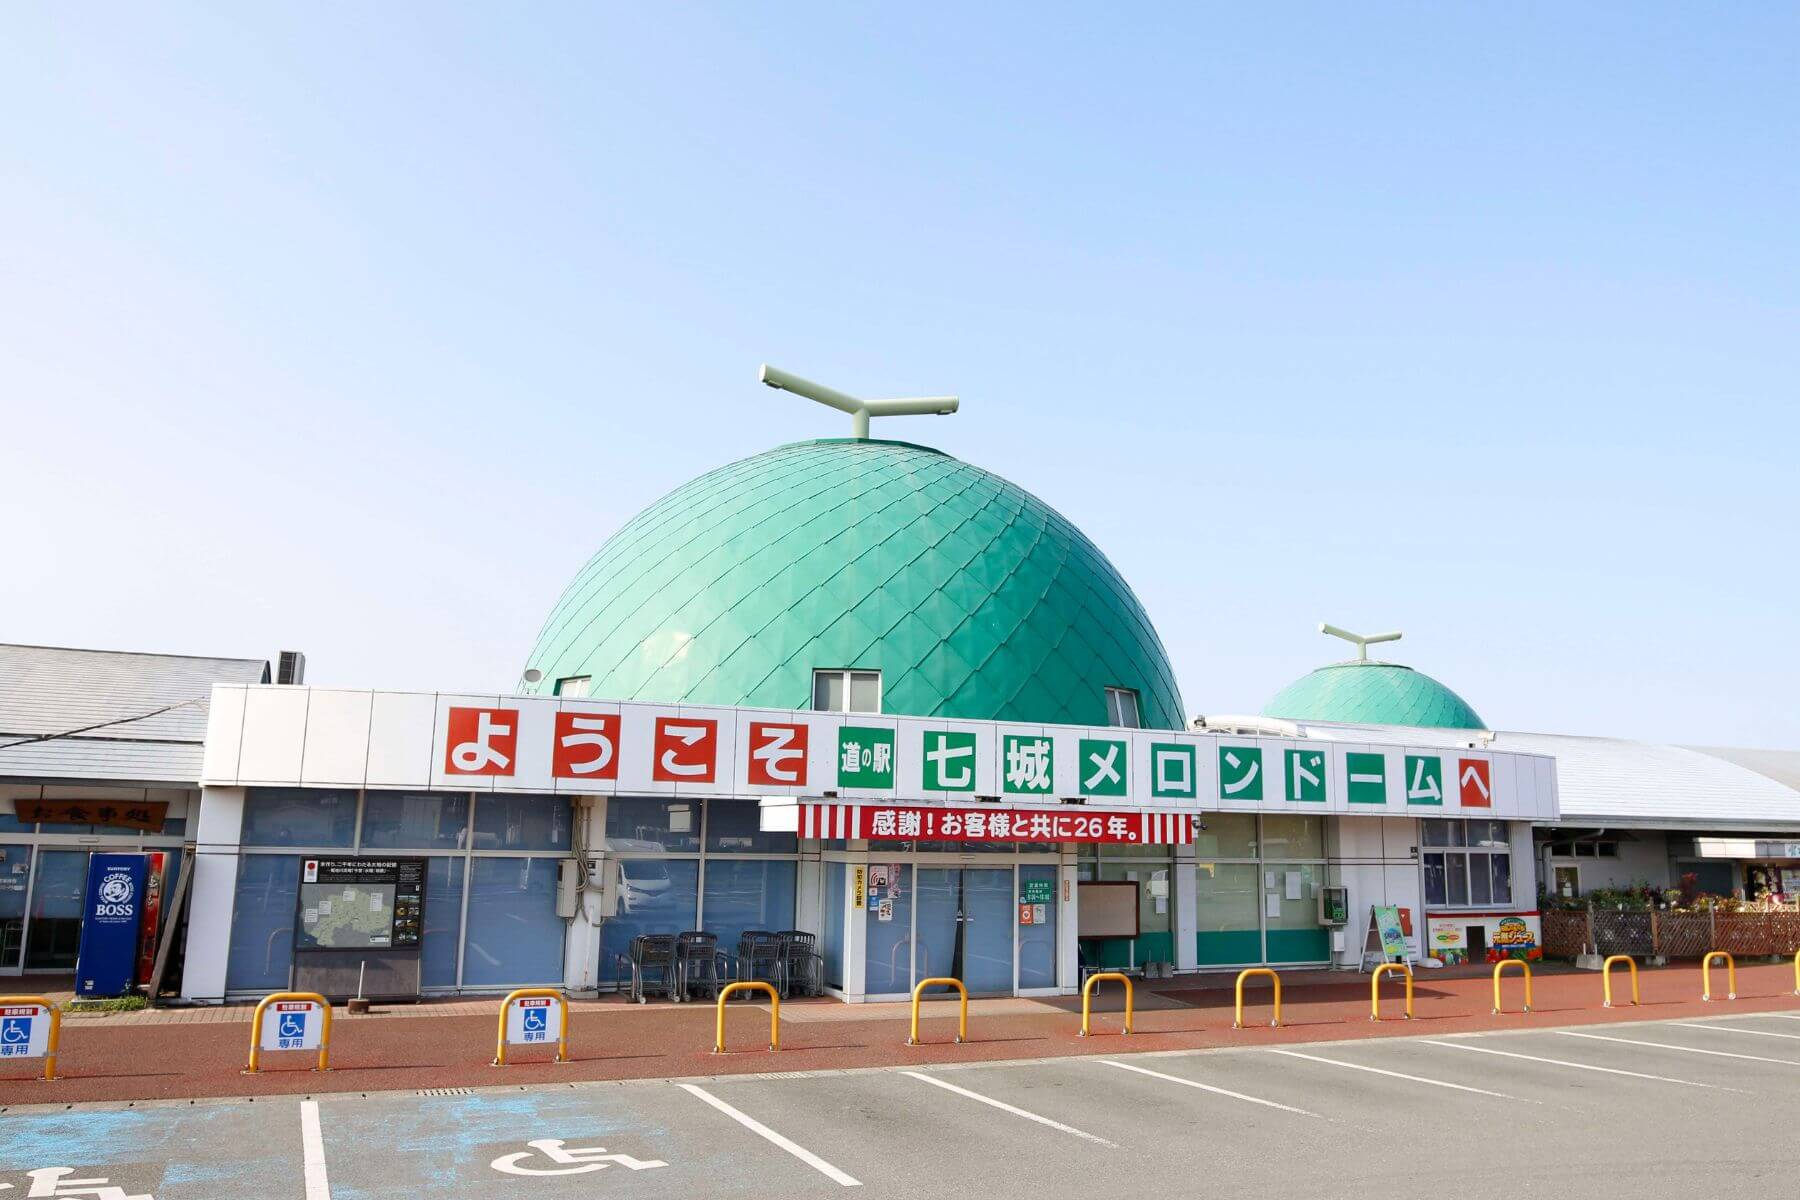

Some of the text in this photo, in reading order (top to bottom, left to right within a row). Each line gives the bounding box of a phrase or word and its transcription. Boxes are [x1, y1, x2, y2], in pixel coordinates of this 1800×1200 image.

[451, 712, 803, 782] ようこそ
[841, 742, 891, 773] 道の駅
[103, 873, 132, 883] COFFEE
[95, 904, 134, 916] BOSS
